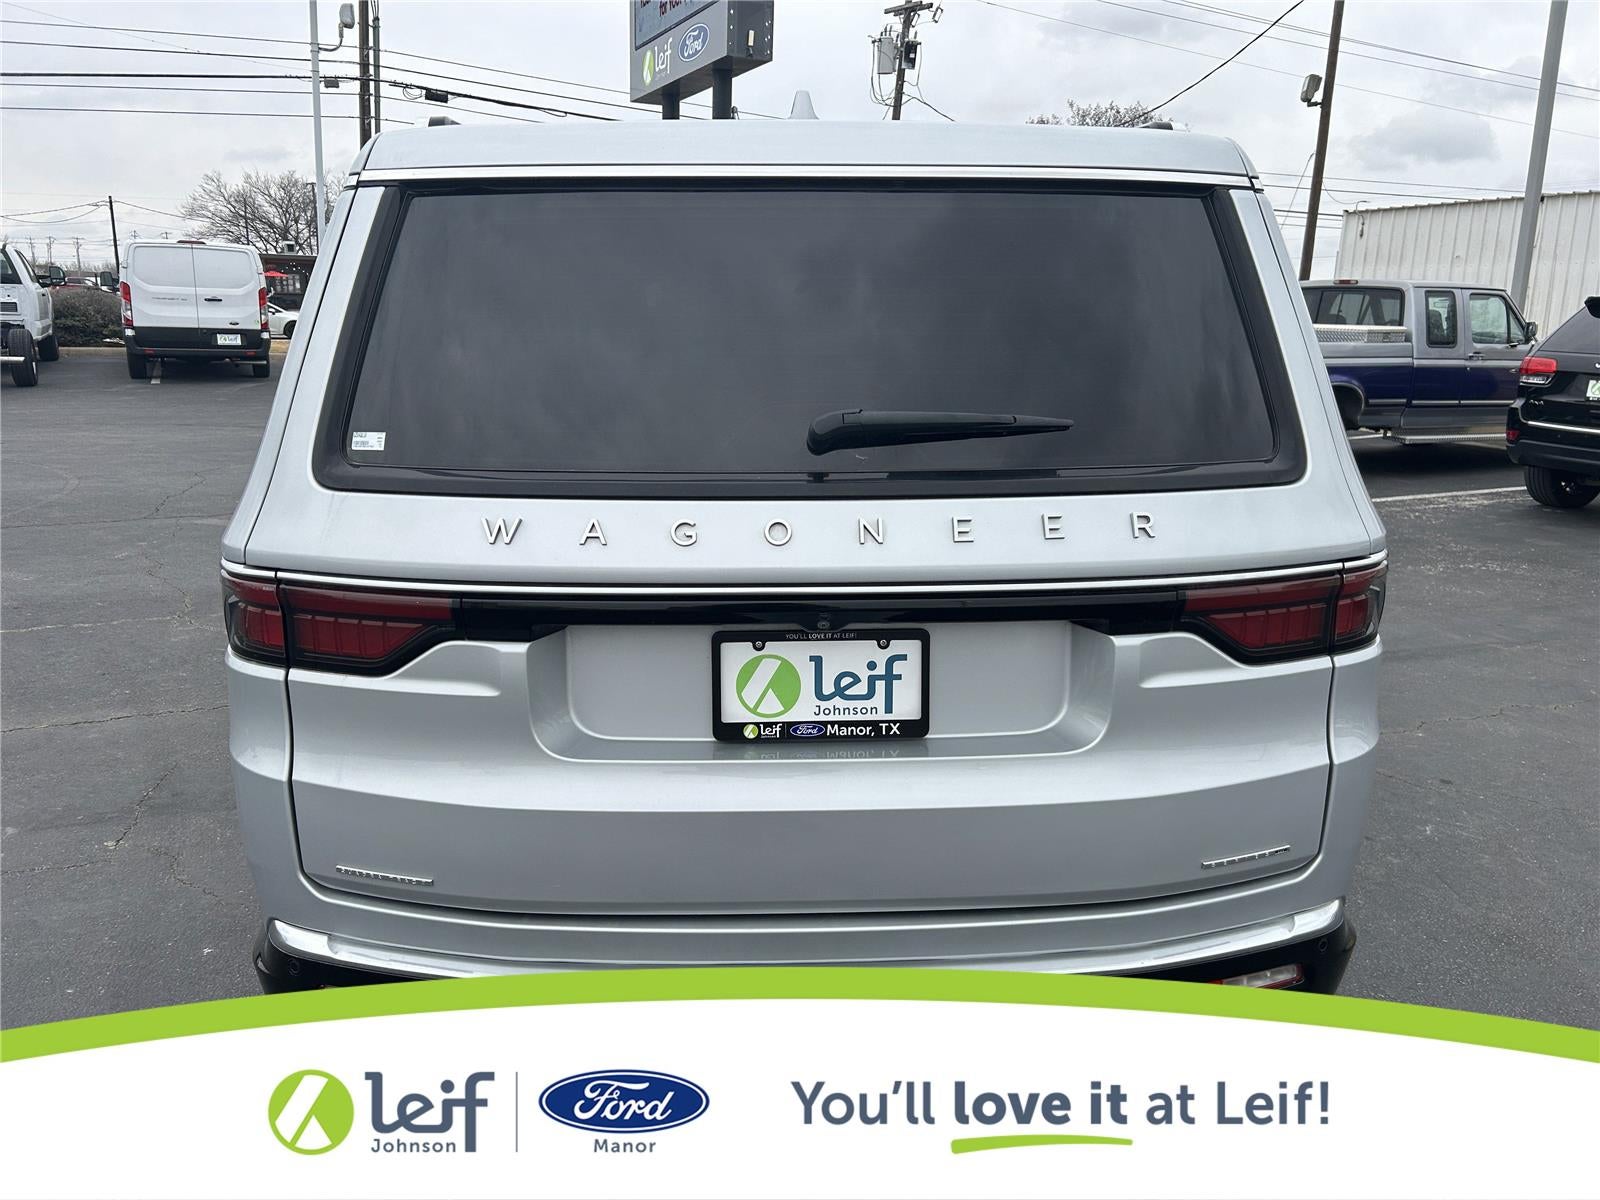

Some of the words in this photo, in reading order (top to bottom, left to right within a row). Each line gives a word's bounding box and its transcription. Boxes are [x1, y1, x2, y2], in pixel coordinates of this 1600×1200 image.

[683, 29, 704, 57] Ford
[654, 37, 672, 74] leif
[481, 511, 1155, 546] WAGONEER
[808, 632, 825, 640] LOVE
[809, 654, 907, 714] leif
[814, 704, 879, 716] Johnson
[759, 723, 783, 738] leif
[797, 725, 818, 735] Ford
[826, 723, 875, 737] Manor,
[879, 722, 901, 735] TX
